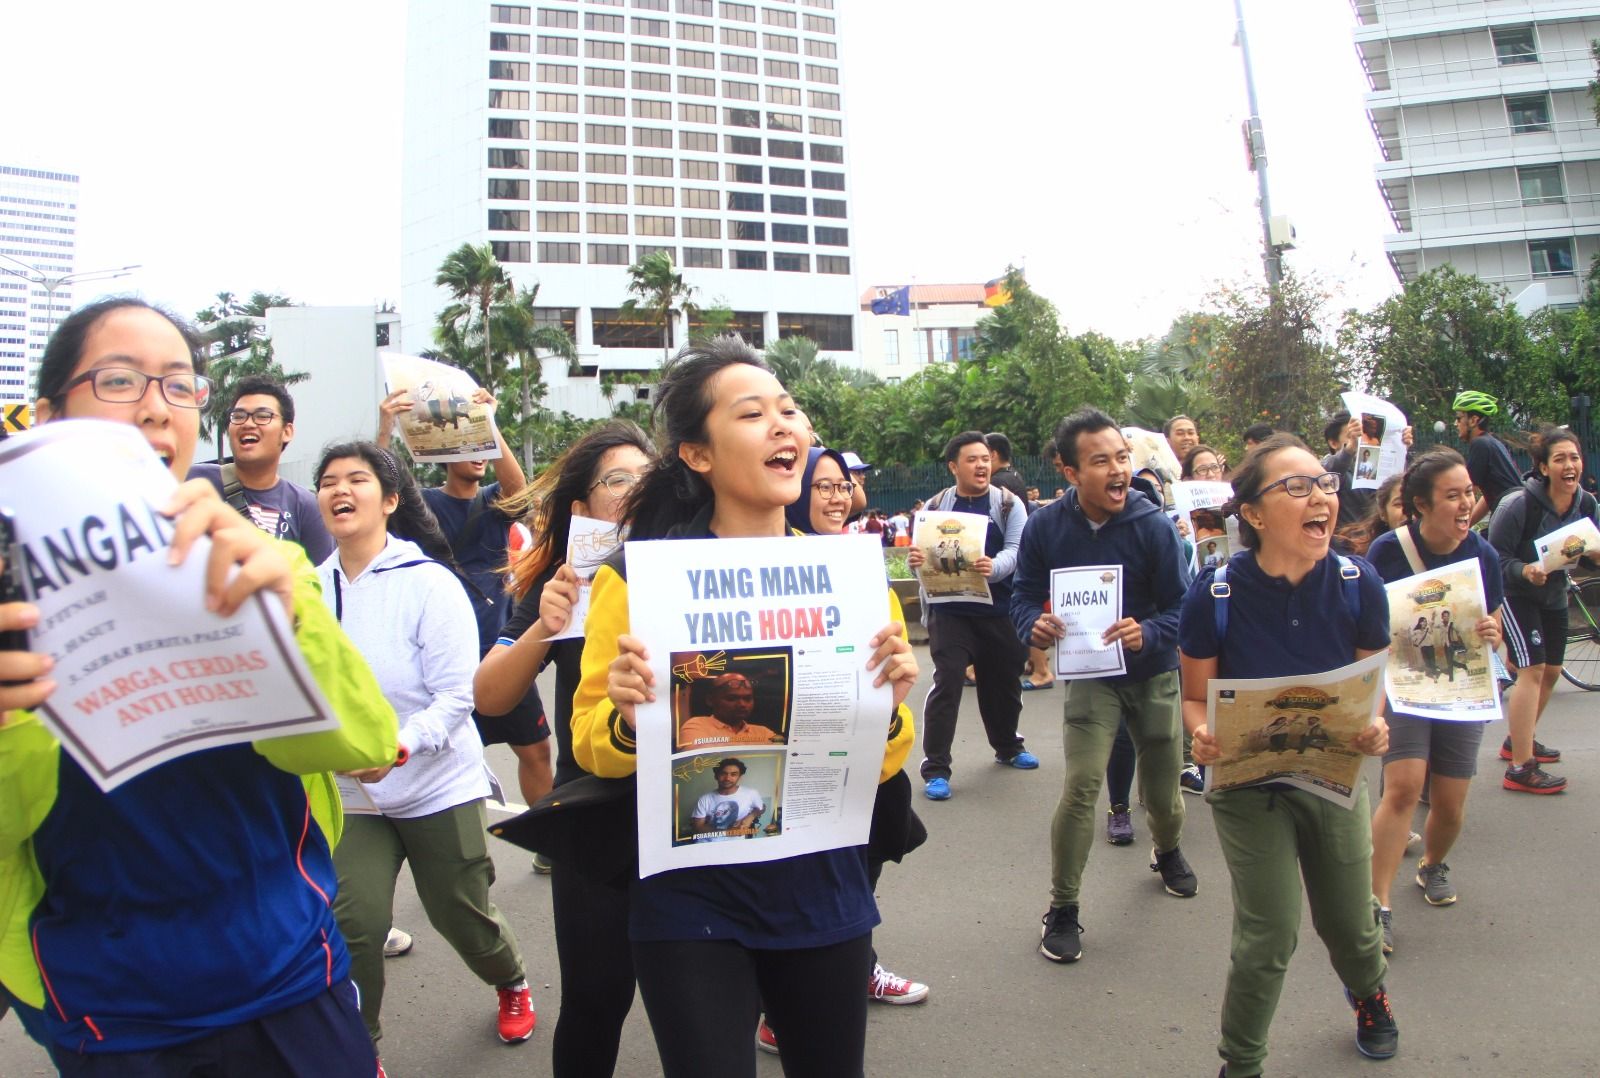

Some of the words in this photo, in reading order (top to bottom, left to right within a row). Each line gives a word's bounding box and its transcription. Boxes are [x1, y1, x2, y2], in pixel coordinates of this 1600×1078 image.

[686, 567, 754, 600] YANG
[760, 564, 832, 597] MANA
[1060, 590, 1108, 607] JANGAN
[684, 610, 752, 644] YANG
[759, 605, 841, 641] HOAX?
[74, 666, 169, 715] WARGA
[169, 649, 268, 680] CERDAS
[117, 694, 176, 727] ANTI
[176, 679, 258, 706] HOAX!
